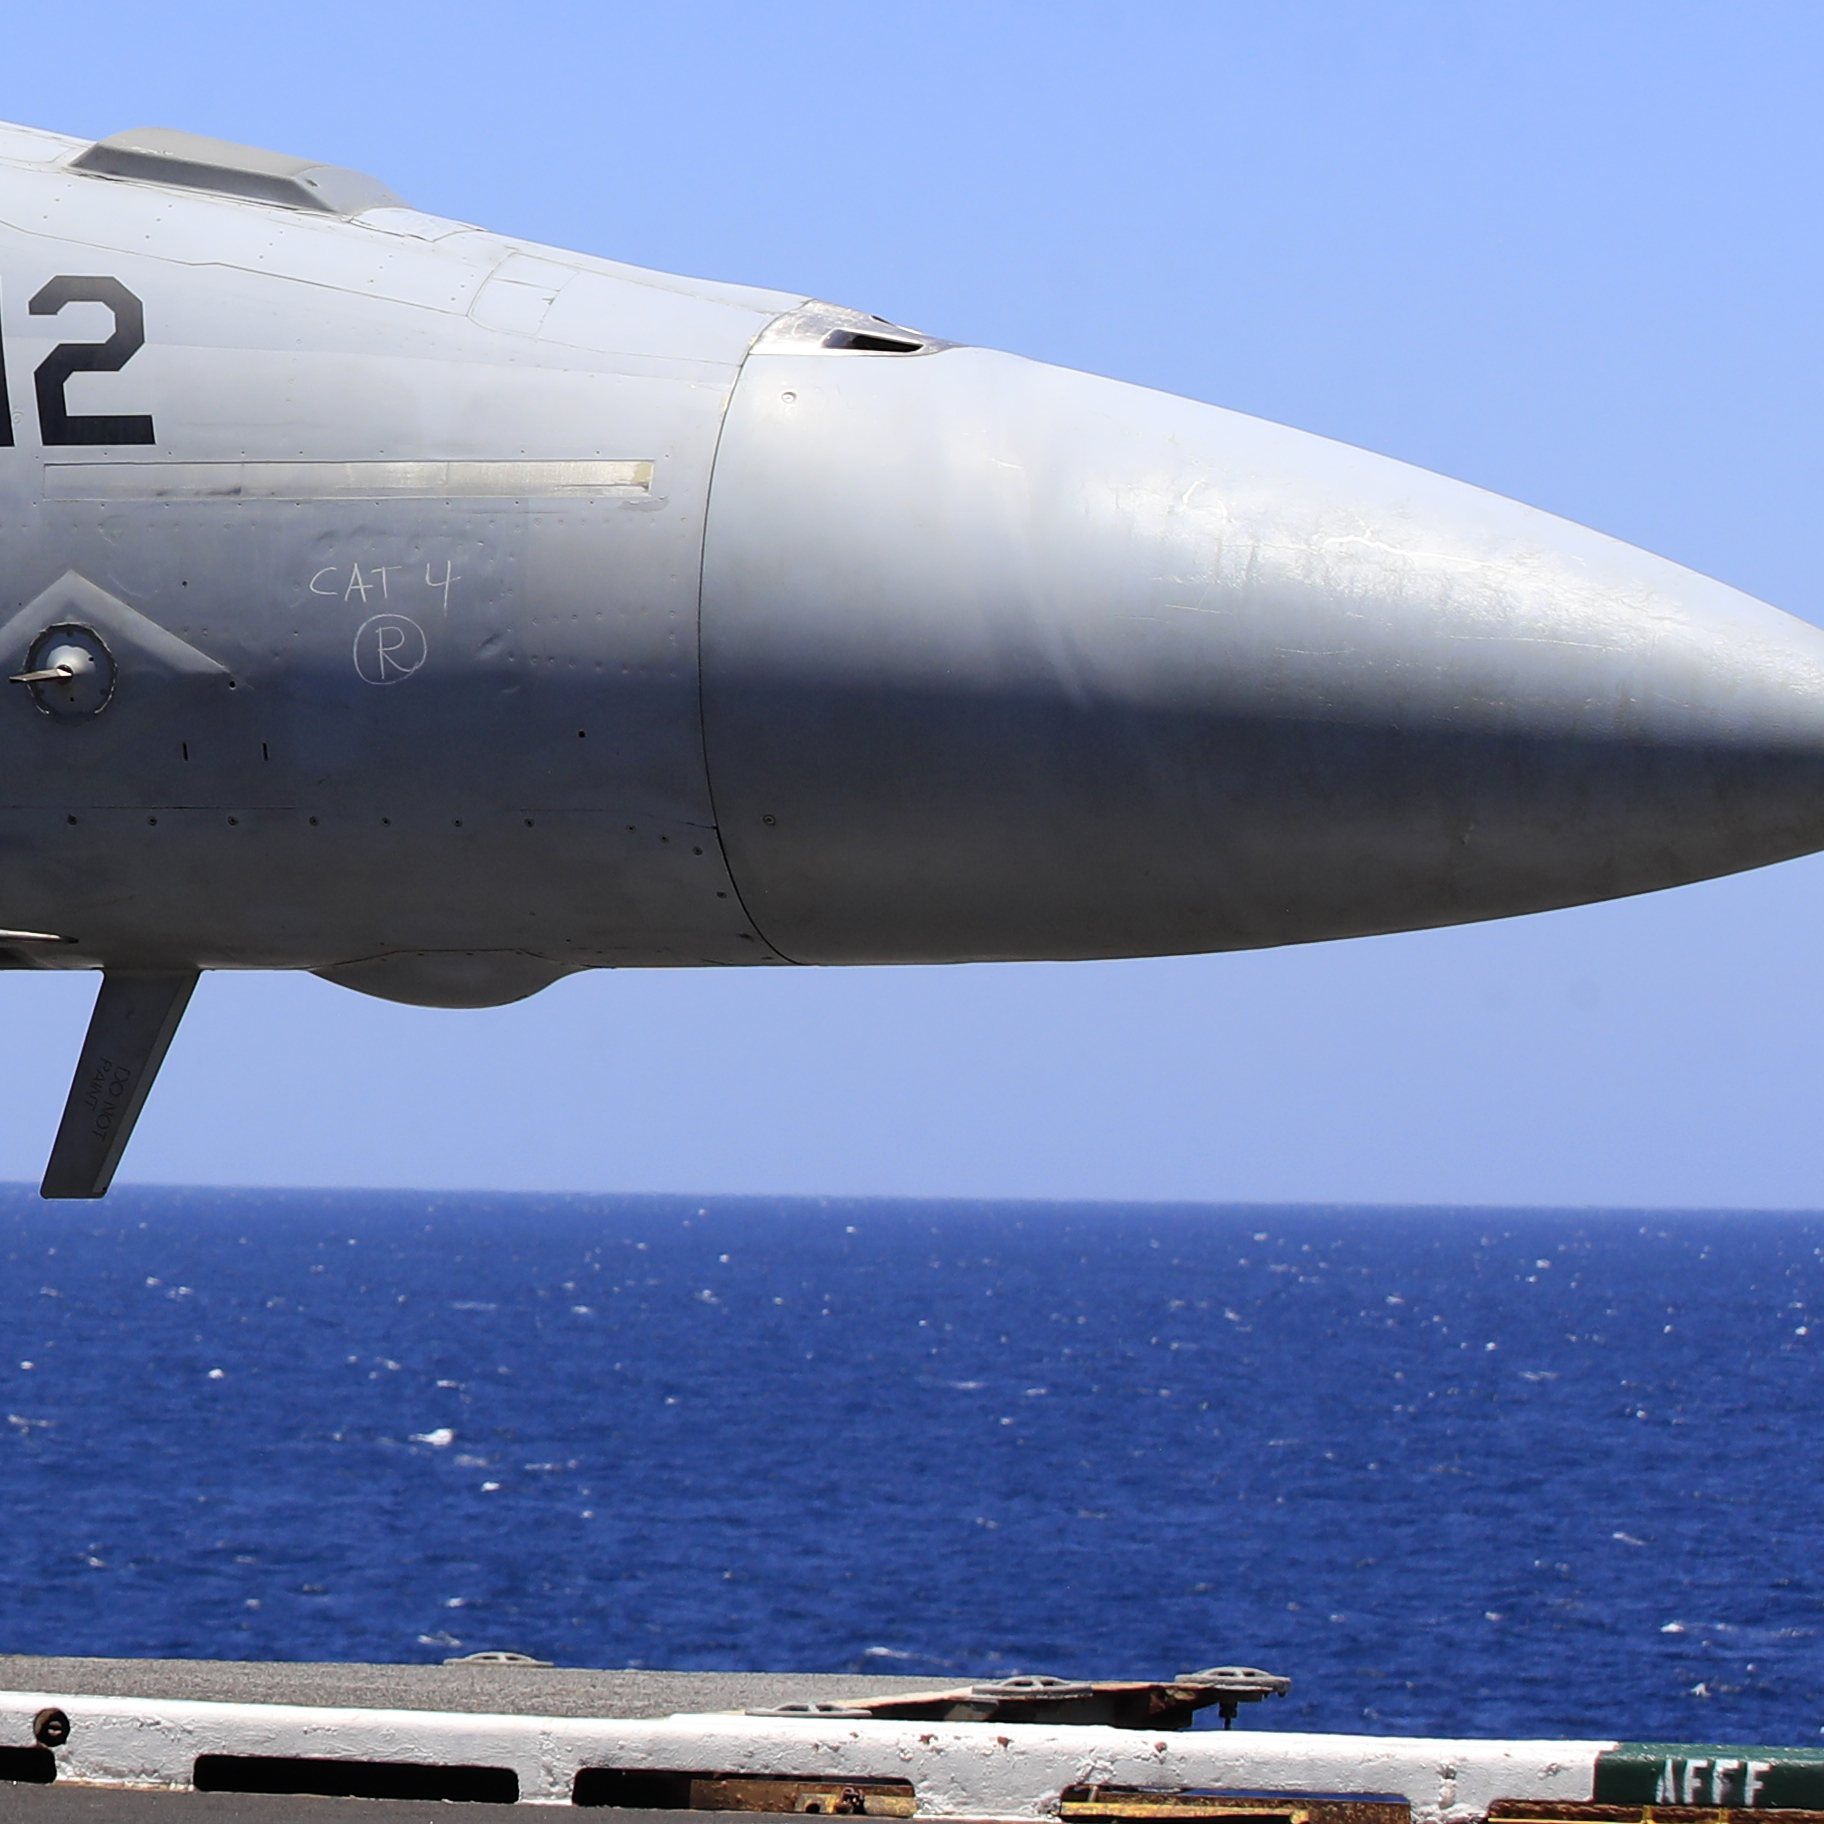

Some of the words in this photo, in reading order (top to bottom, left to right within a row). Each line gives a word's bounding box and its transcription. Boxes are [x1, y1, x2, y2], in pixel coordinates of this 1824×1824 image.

[309, 563, 401, 604] CAT
[424, 559, 461, 615] 4
[375, 626, 414, 680] R
[84, 1057, 112, 1112] PAINT
[108, 1065, 131, 1097] DO
[92, 1100, 116, 1143] NOT
[1654, 1758, 1773, 1807] AFFF
